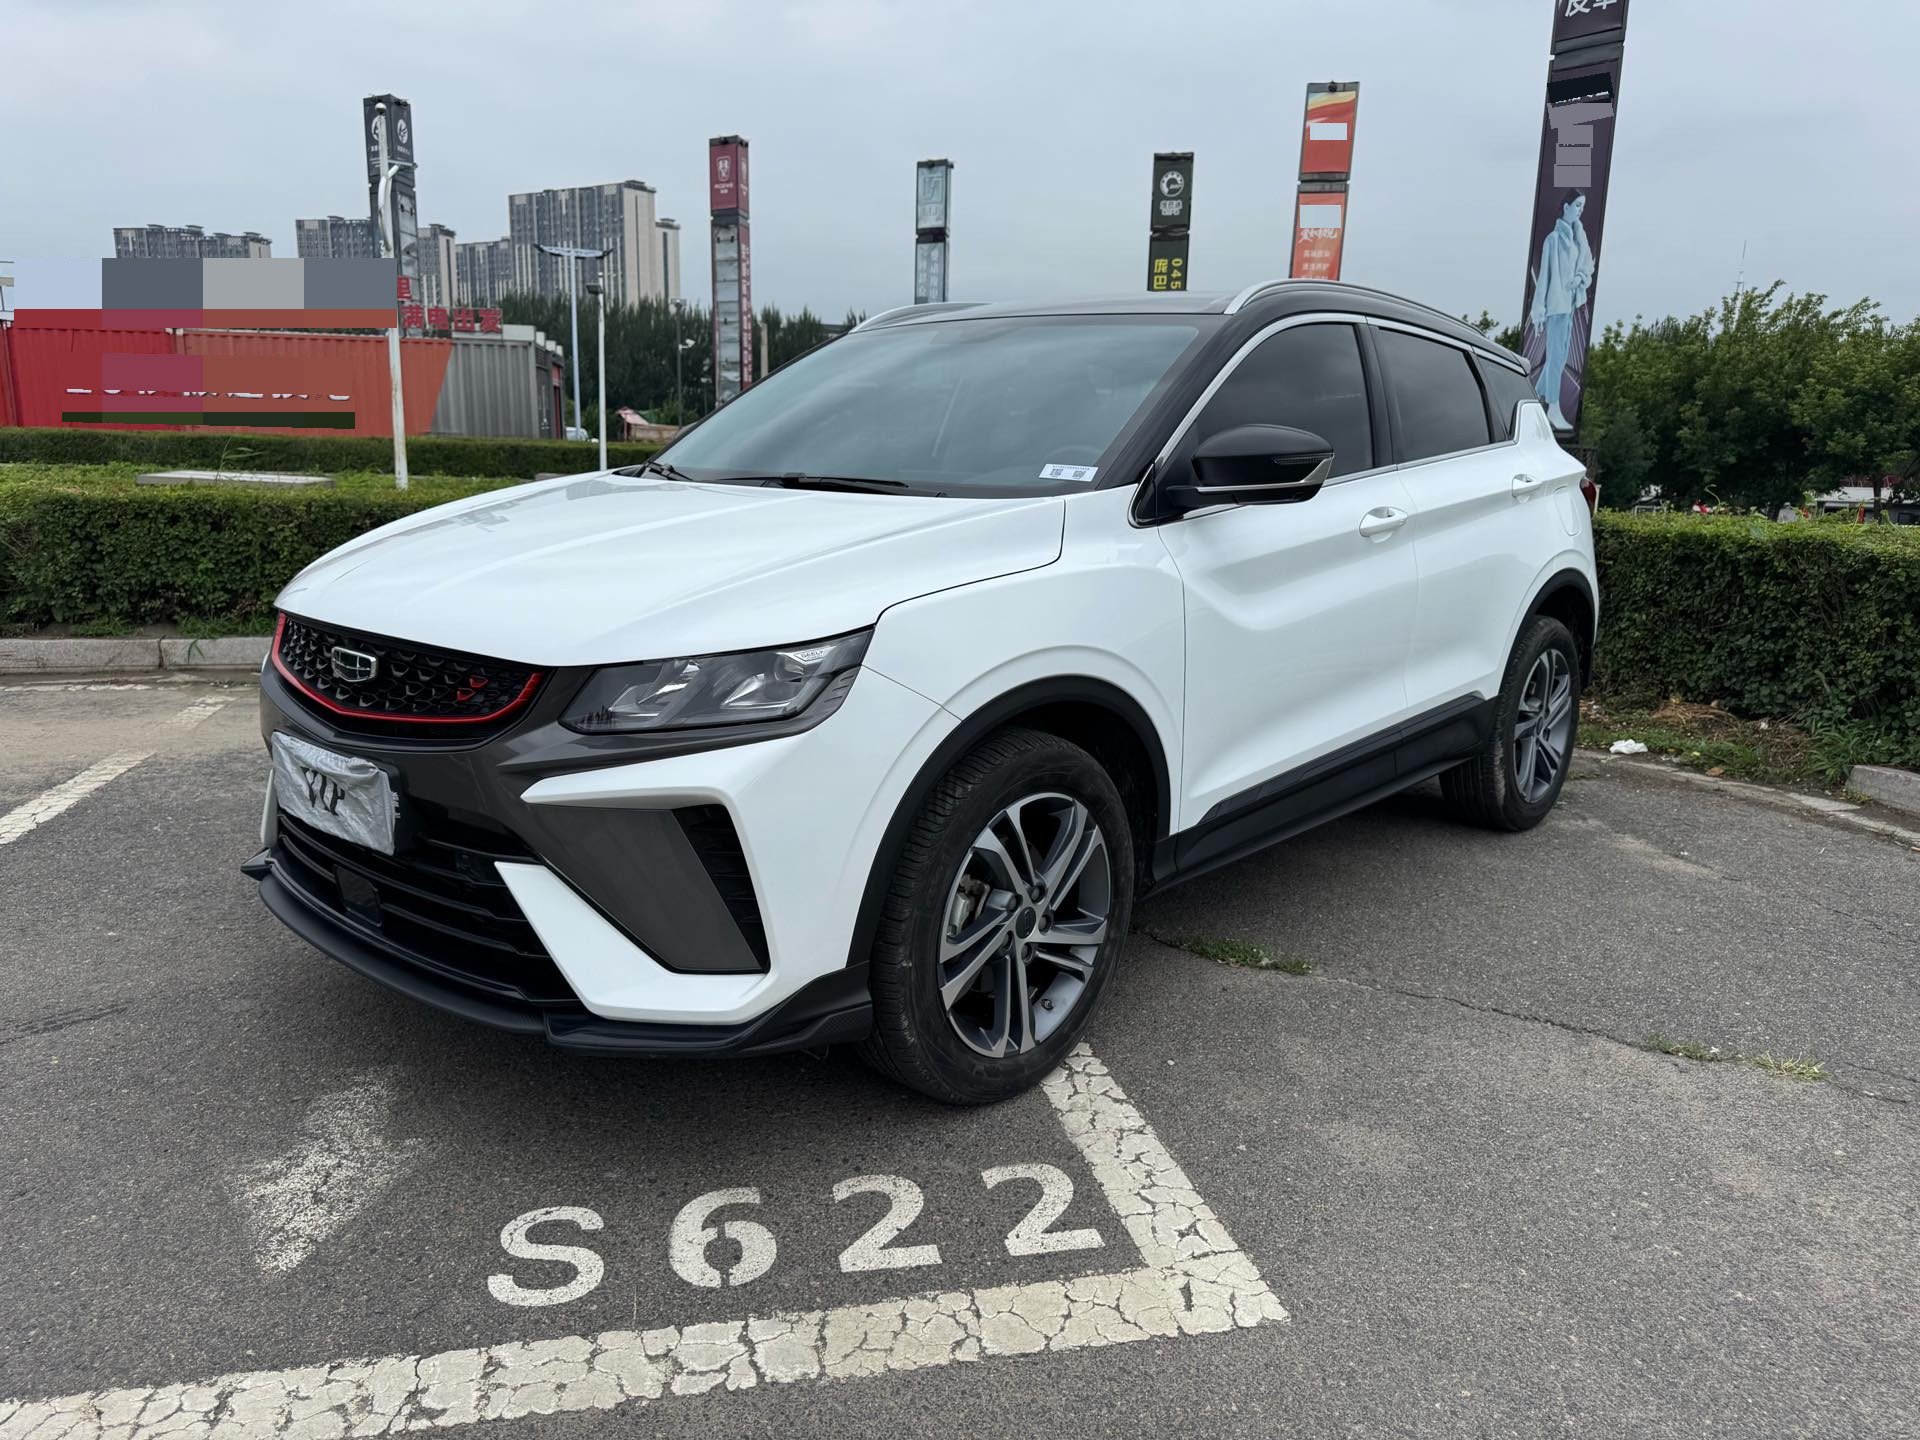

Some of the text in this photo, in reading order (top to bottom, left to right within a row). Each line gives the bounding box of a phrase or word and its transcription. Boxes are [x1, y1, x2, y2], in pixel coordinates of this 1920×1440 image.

[400, 304, 503, 333] 满电出发
[487, 1162, 1105, 1308] S622
